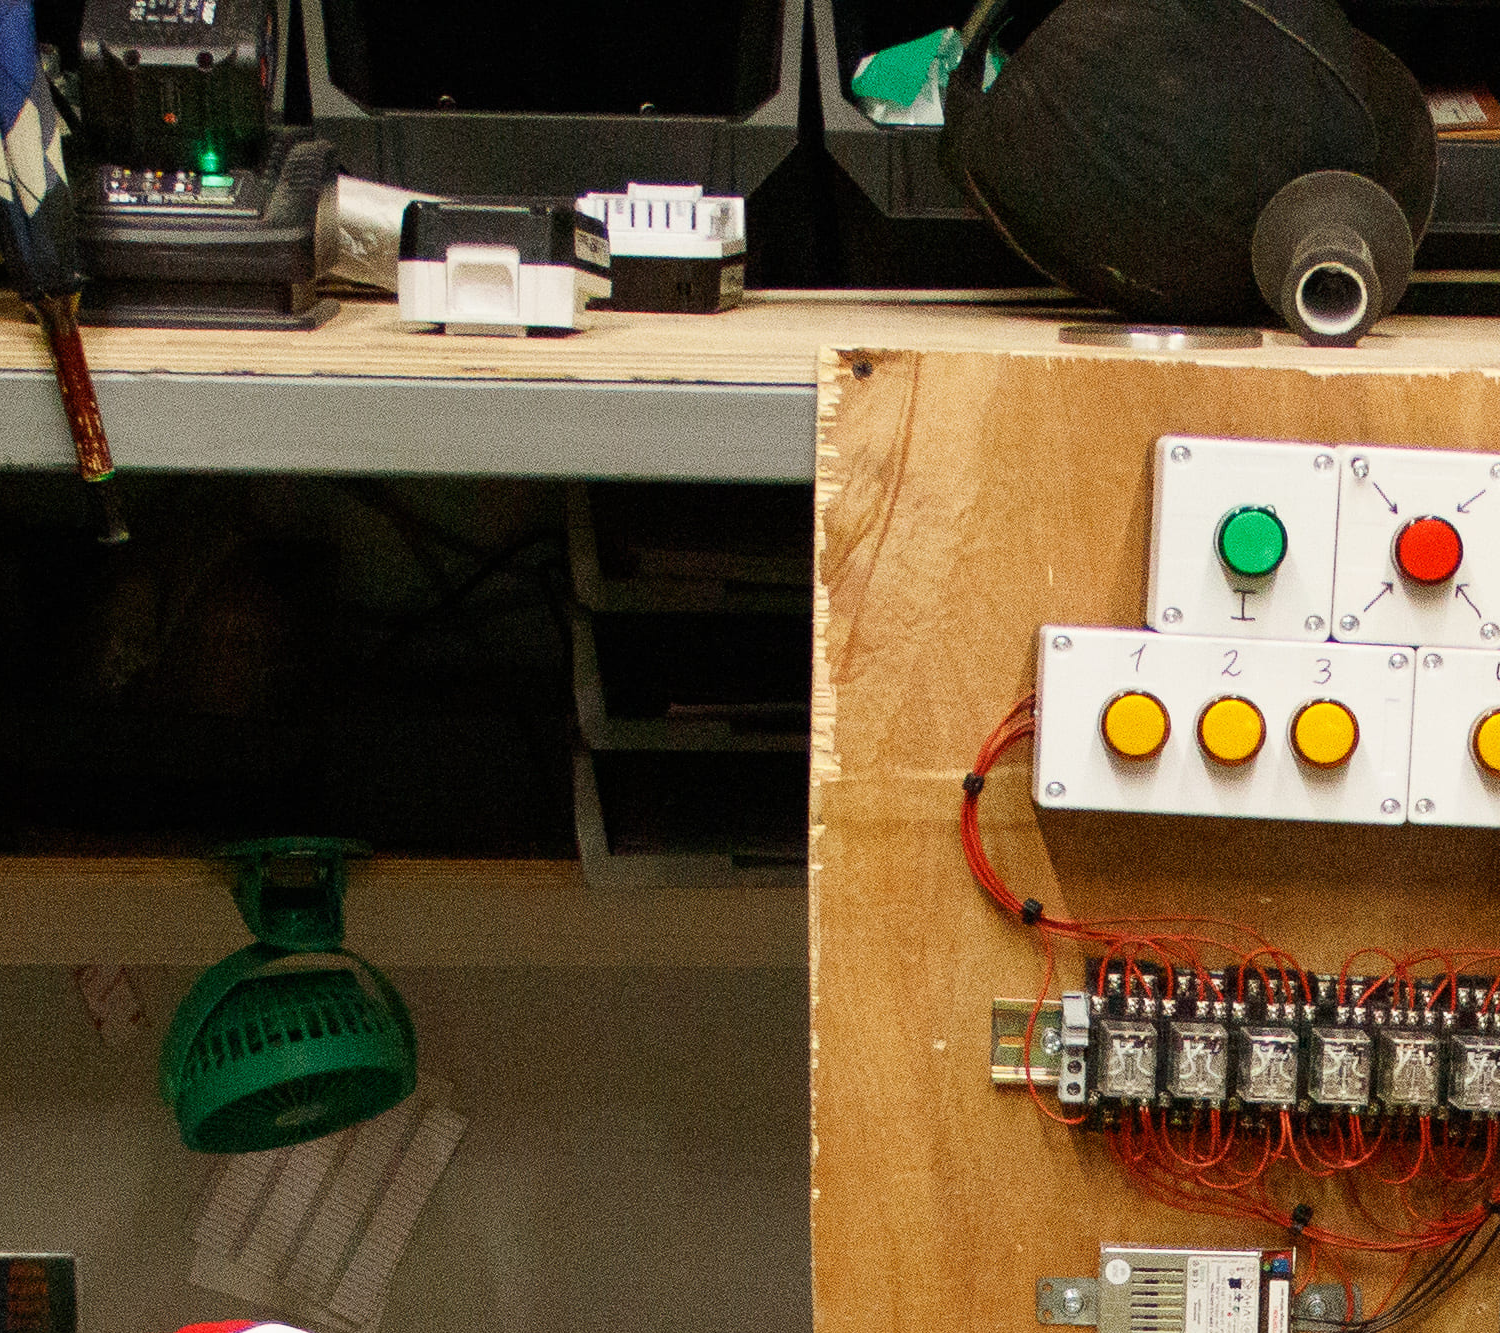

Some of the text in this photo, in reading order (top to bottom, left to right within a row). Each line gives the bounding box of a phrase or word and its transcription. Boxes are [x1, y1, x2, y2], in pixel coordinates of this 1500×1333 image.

[1129, 643, 1334, 686] 1 2 3
